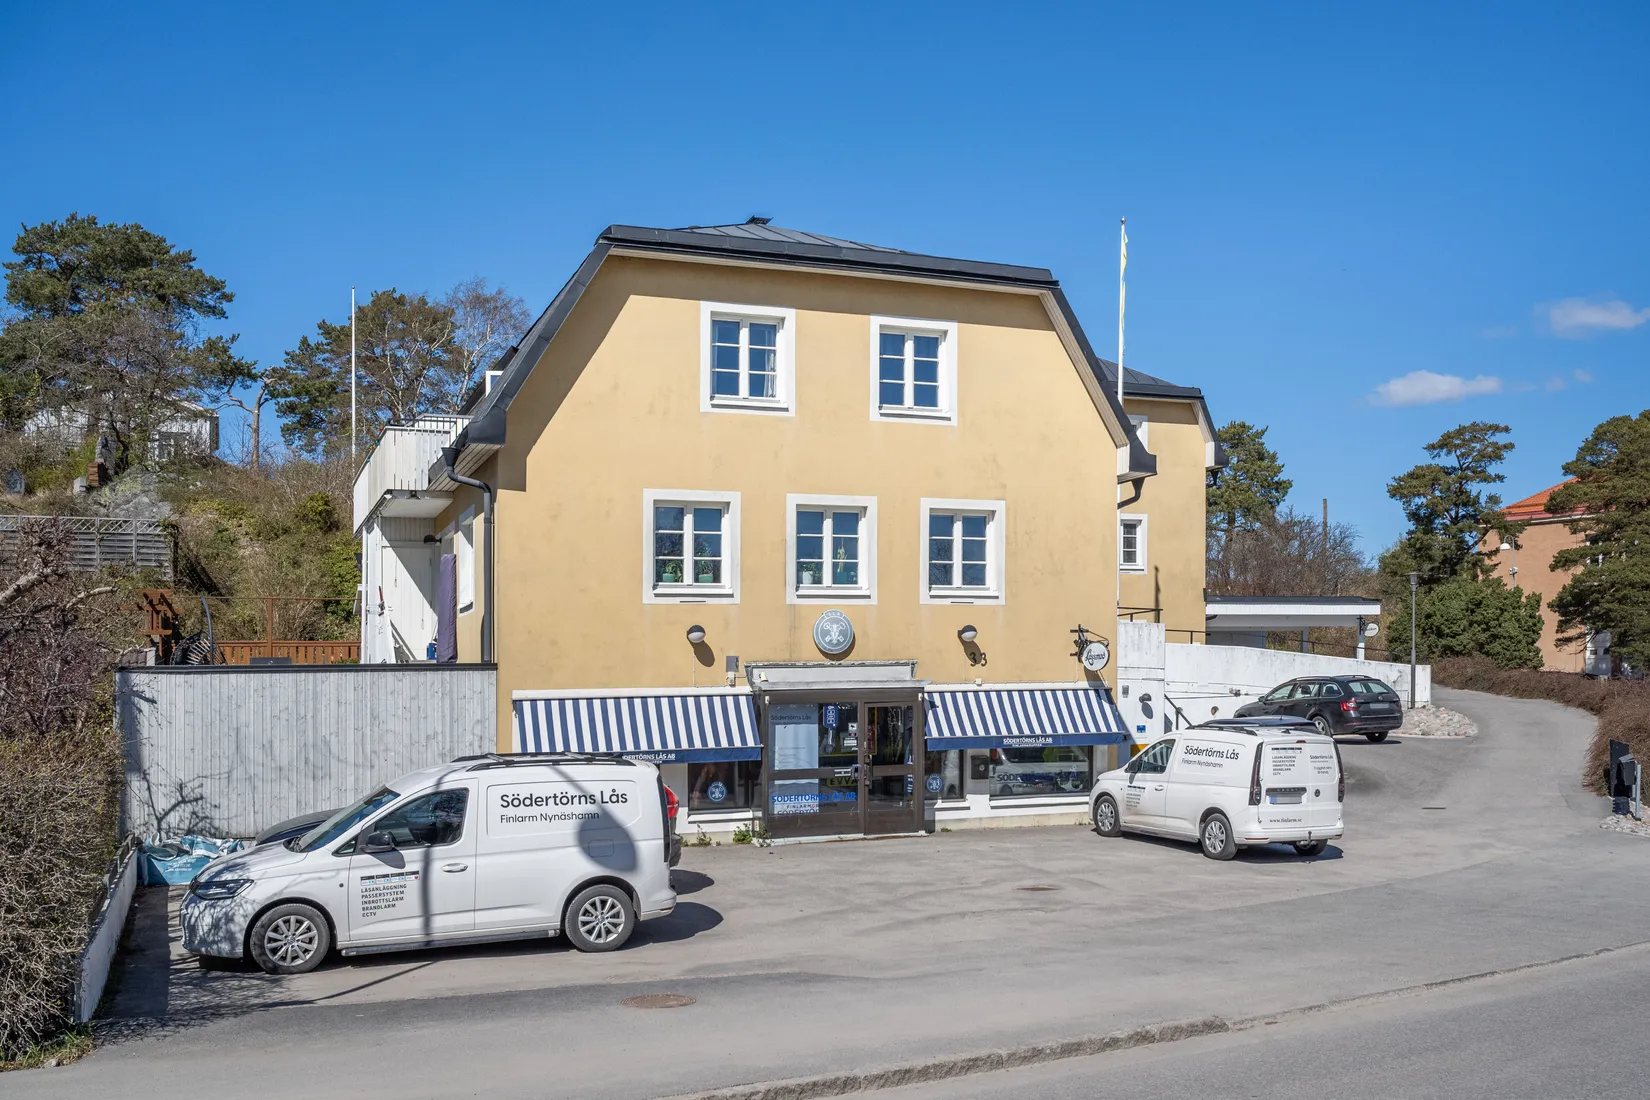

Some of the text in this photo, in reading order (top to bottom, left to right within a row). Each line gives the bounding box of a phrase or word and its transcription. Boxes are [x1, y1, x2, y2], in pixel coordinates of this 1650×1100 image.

[655, 752, 666, 760] LÅS
[1184, 745, 1240, 760] Södertörns Lås
[830, 777, 857, 785] EVVA
[500, 788, 628, 809] Södertörns Lås
[500, 811, 600, 823] Finlarm Nynäshamn
[361, 890, 405, 899] PASSERSYSTEM
[361, 896, 404, 905] INBROTTSLARM
[362, 903, 396, 912] BRANDLARM
